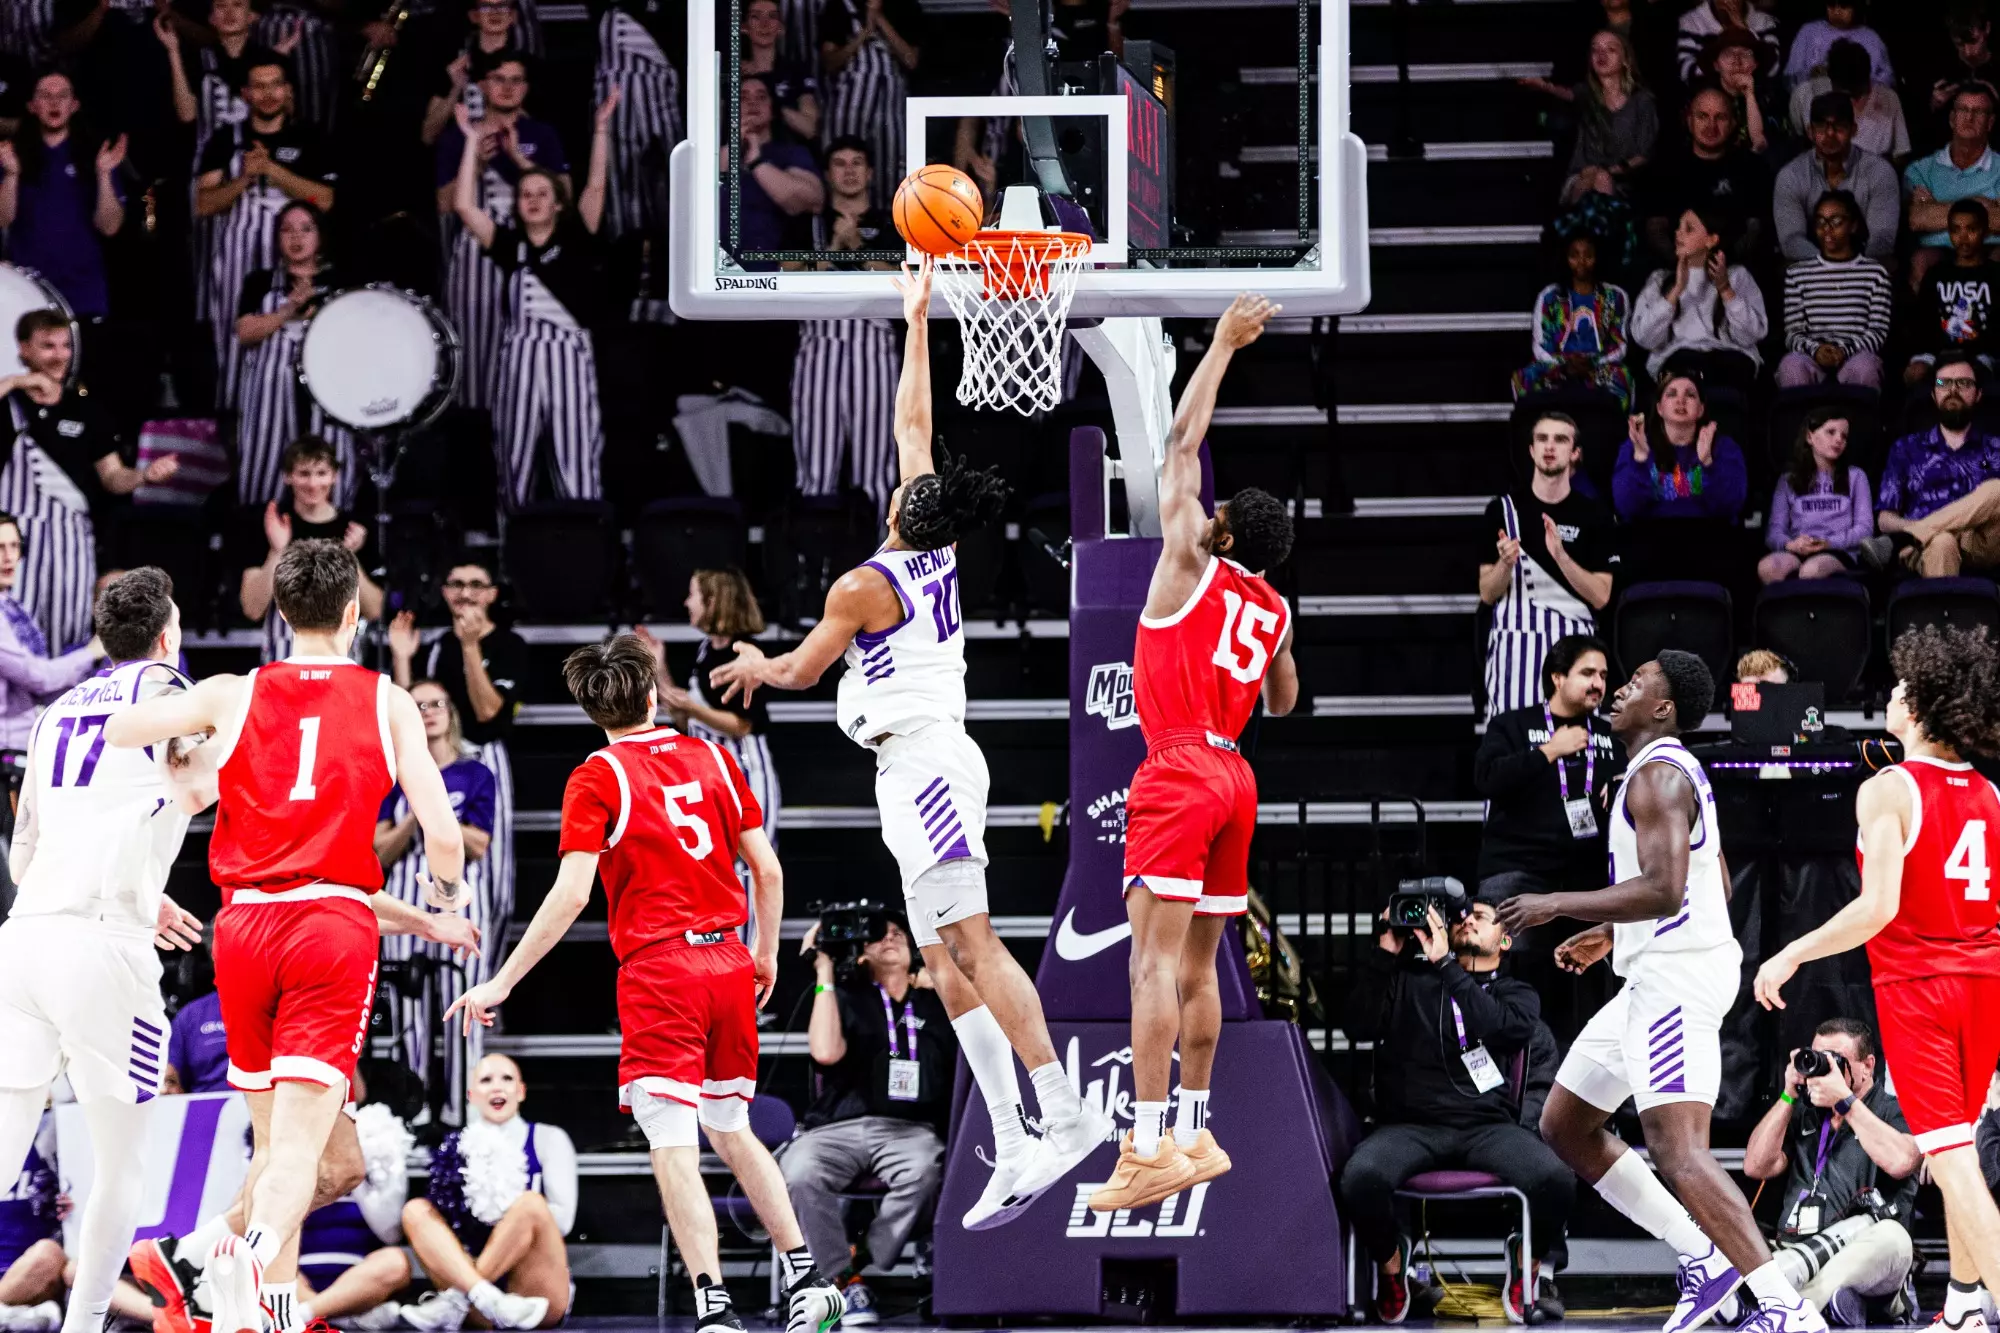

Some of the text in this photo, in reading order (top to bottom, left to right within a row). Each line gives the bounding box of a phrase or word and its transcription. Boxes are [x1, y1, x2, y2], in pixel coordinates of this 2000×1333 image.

[715, 277, 778, 291] SPALDING
[1936, 280, 1991, 304] NASA
[904, 546, 951, 580] HENL
[922, 567, 960, 643] 10
[1212, 589, 1280, 684] 15
[1114, 694, 1137, 719] D
[1528, 729, 1551, 744] GRA
[52, 713, 114, 788] 17
[289, 716, 321, 801] 1
[660, 780, 714, 860] 5
[1944, 819, 1990, 901] 4
[351, 960, 378, 1054] JAGS
